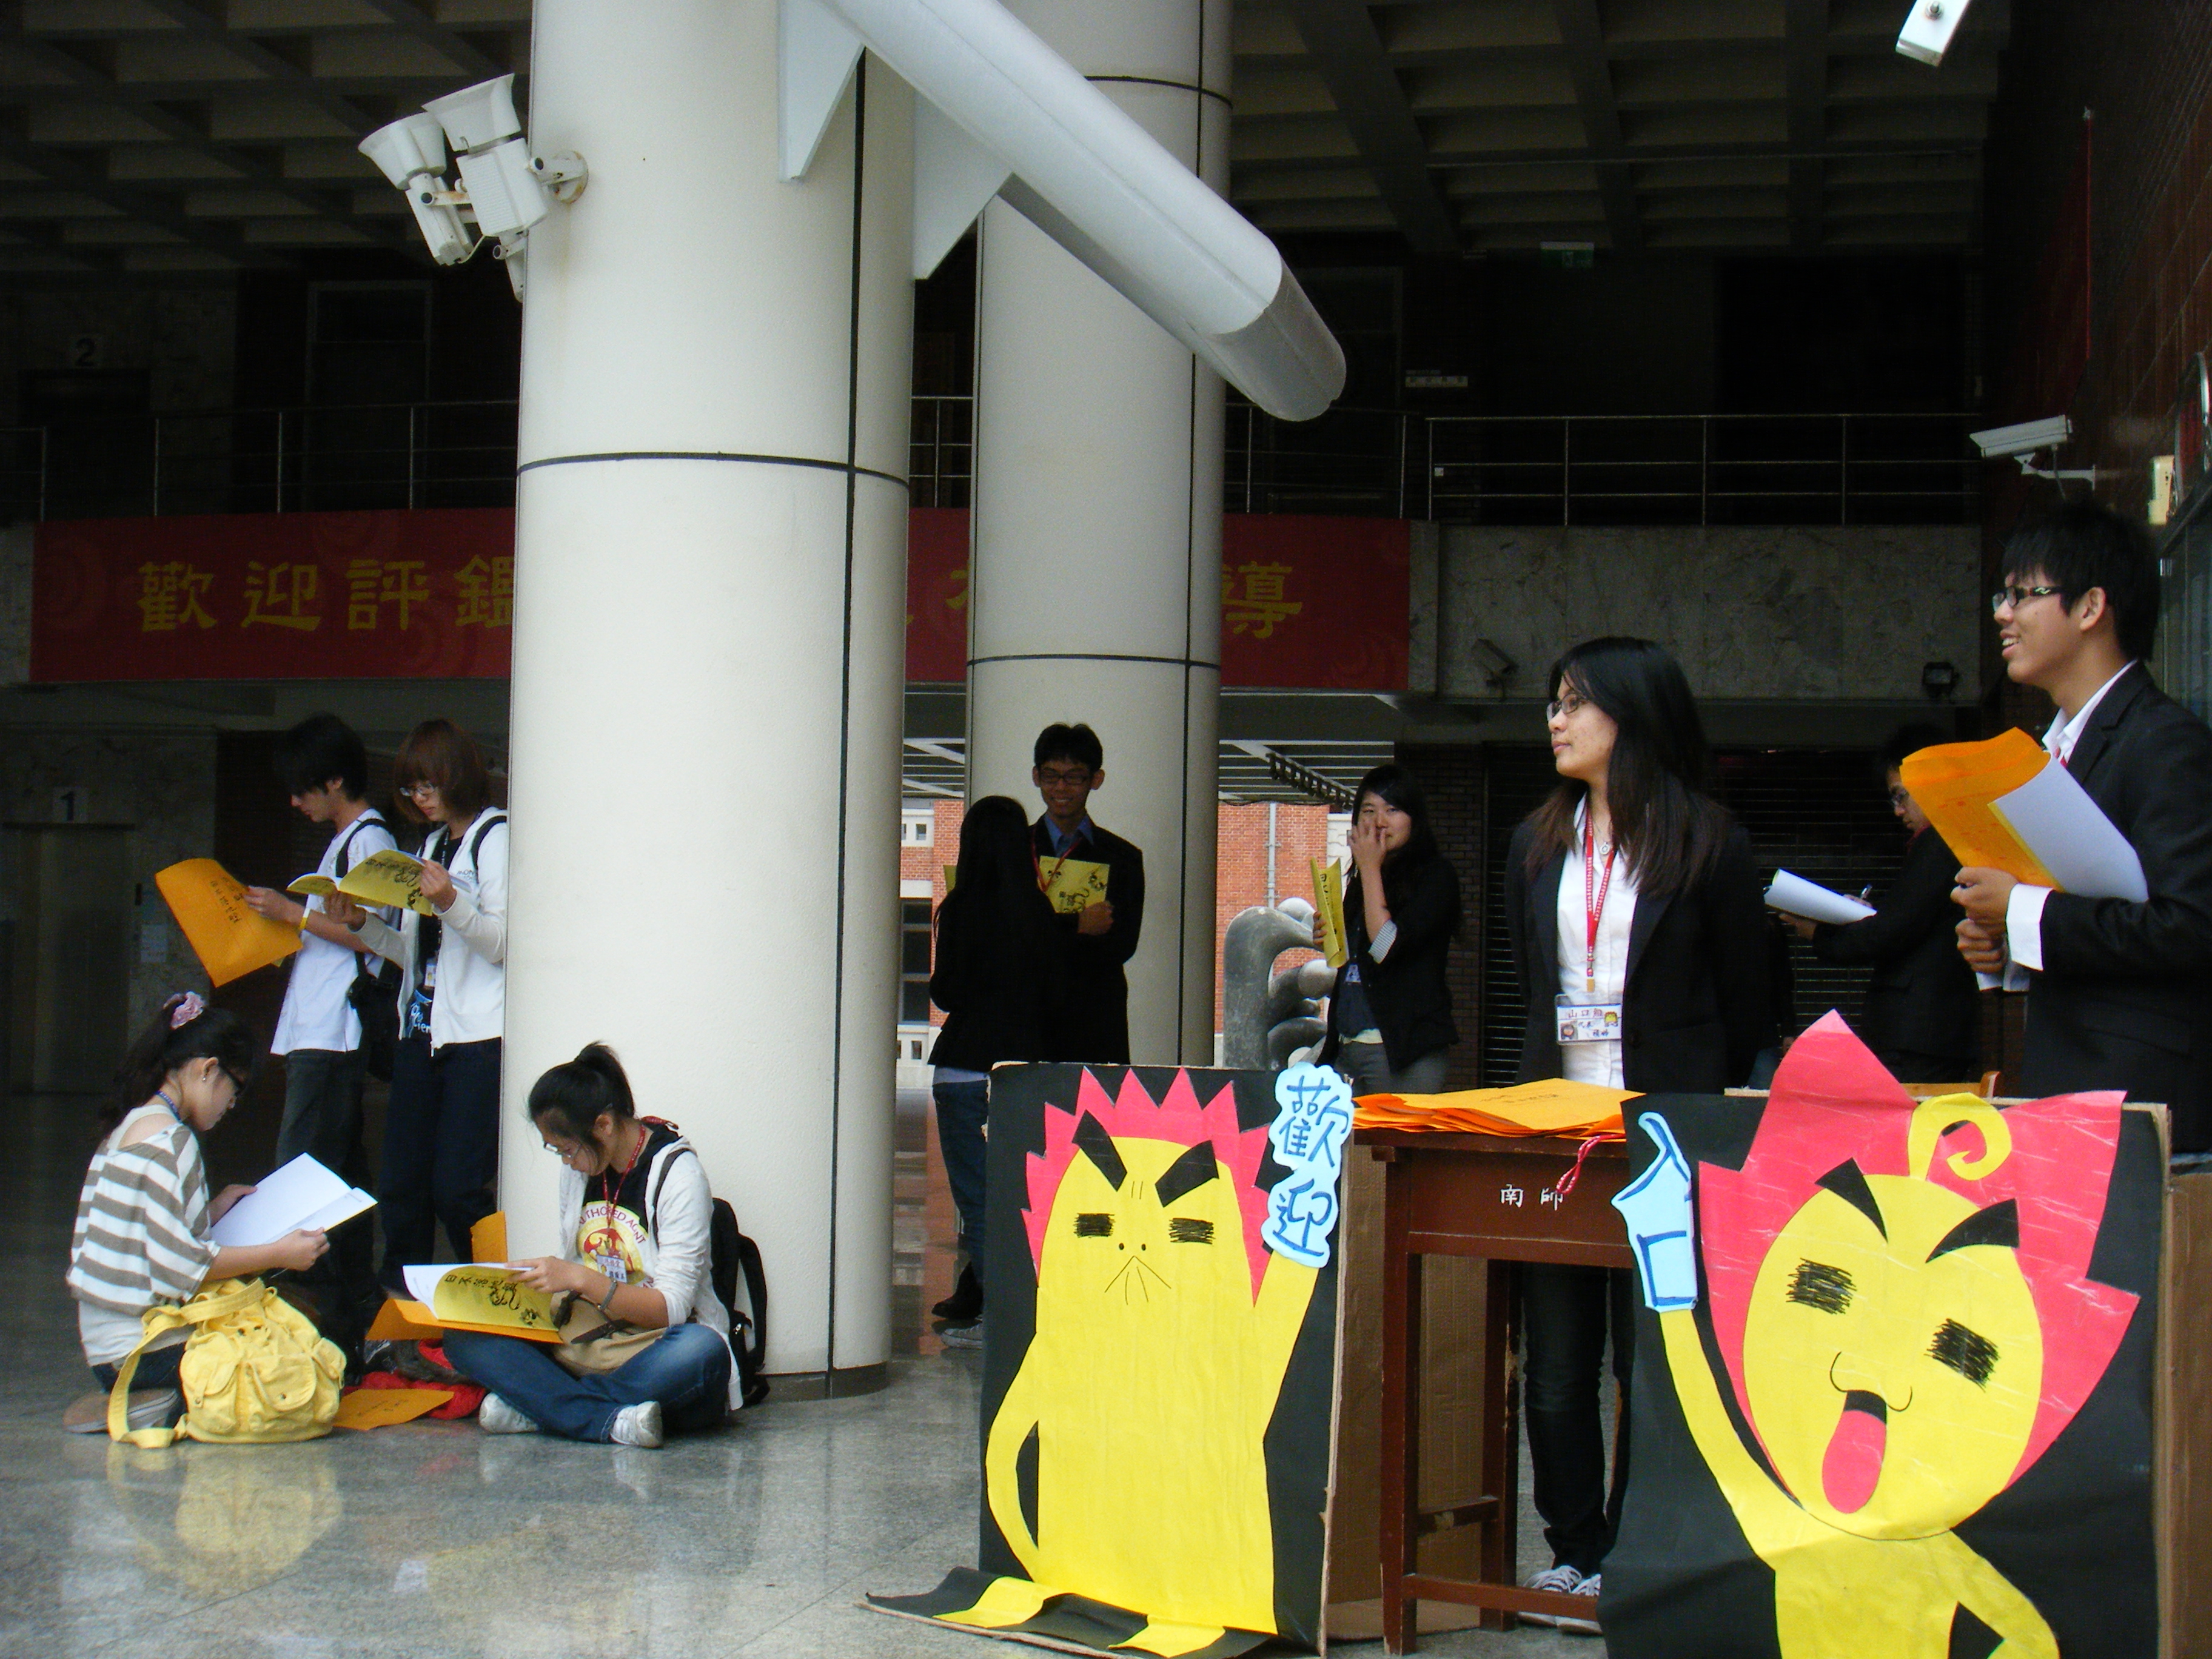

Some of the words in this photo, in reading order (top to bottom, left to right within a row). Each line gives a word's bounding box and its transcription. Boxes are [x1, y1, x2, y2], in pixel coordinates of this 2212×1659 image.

[75, 337, 95, 367] 2
[1222, 561, 1302, 639] 導
[61, 791, 76, 821] 1
[1272, 1074, 1351, 1258] 歡迎
